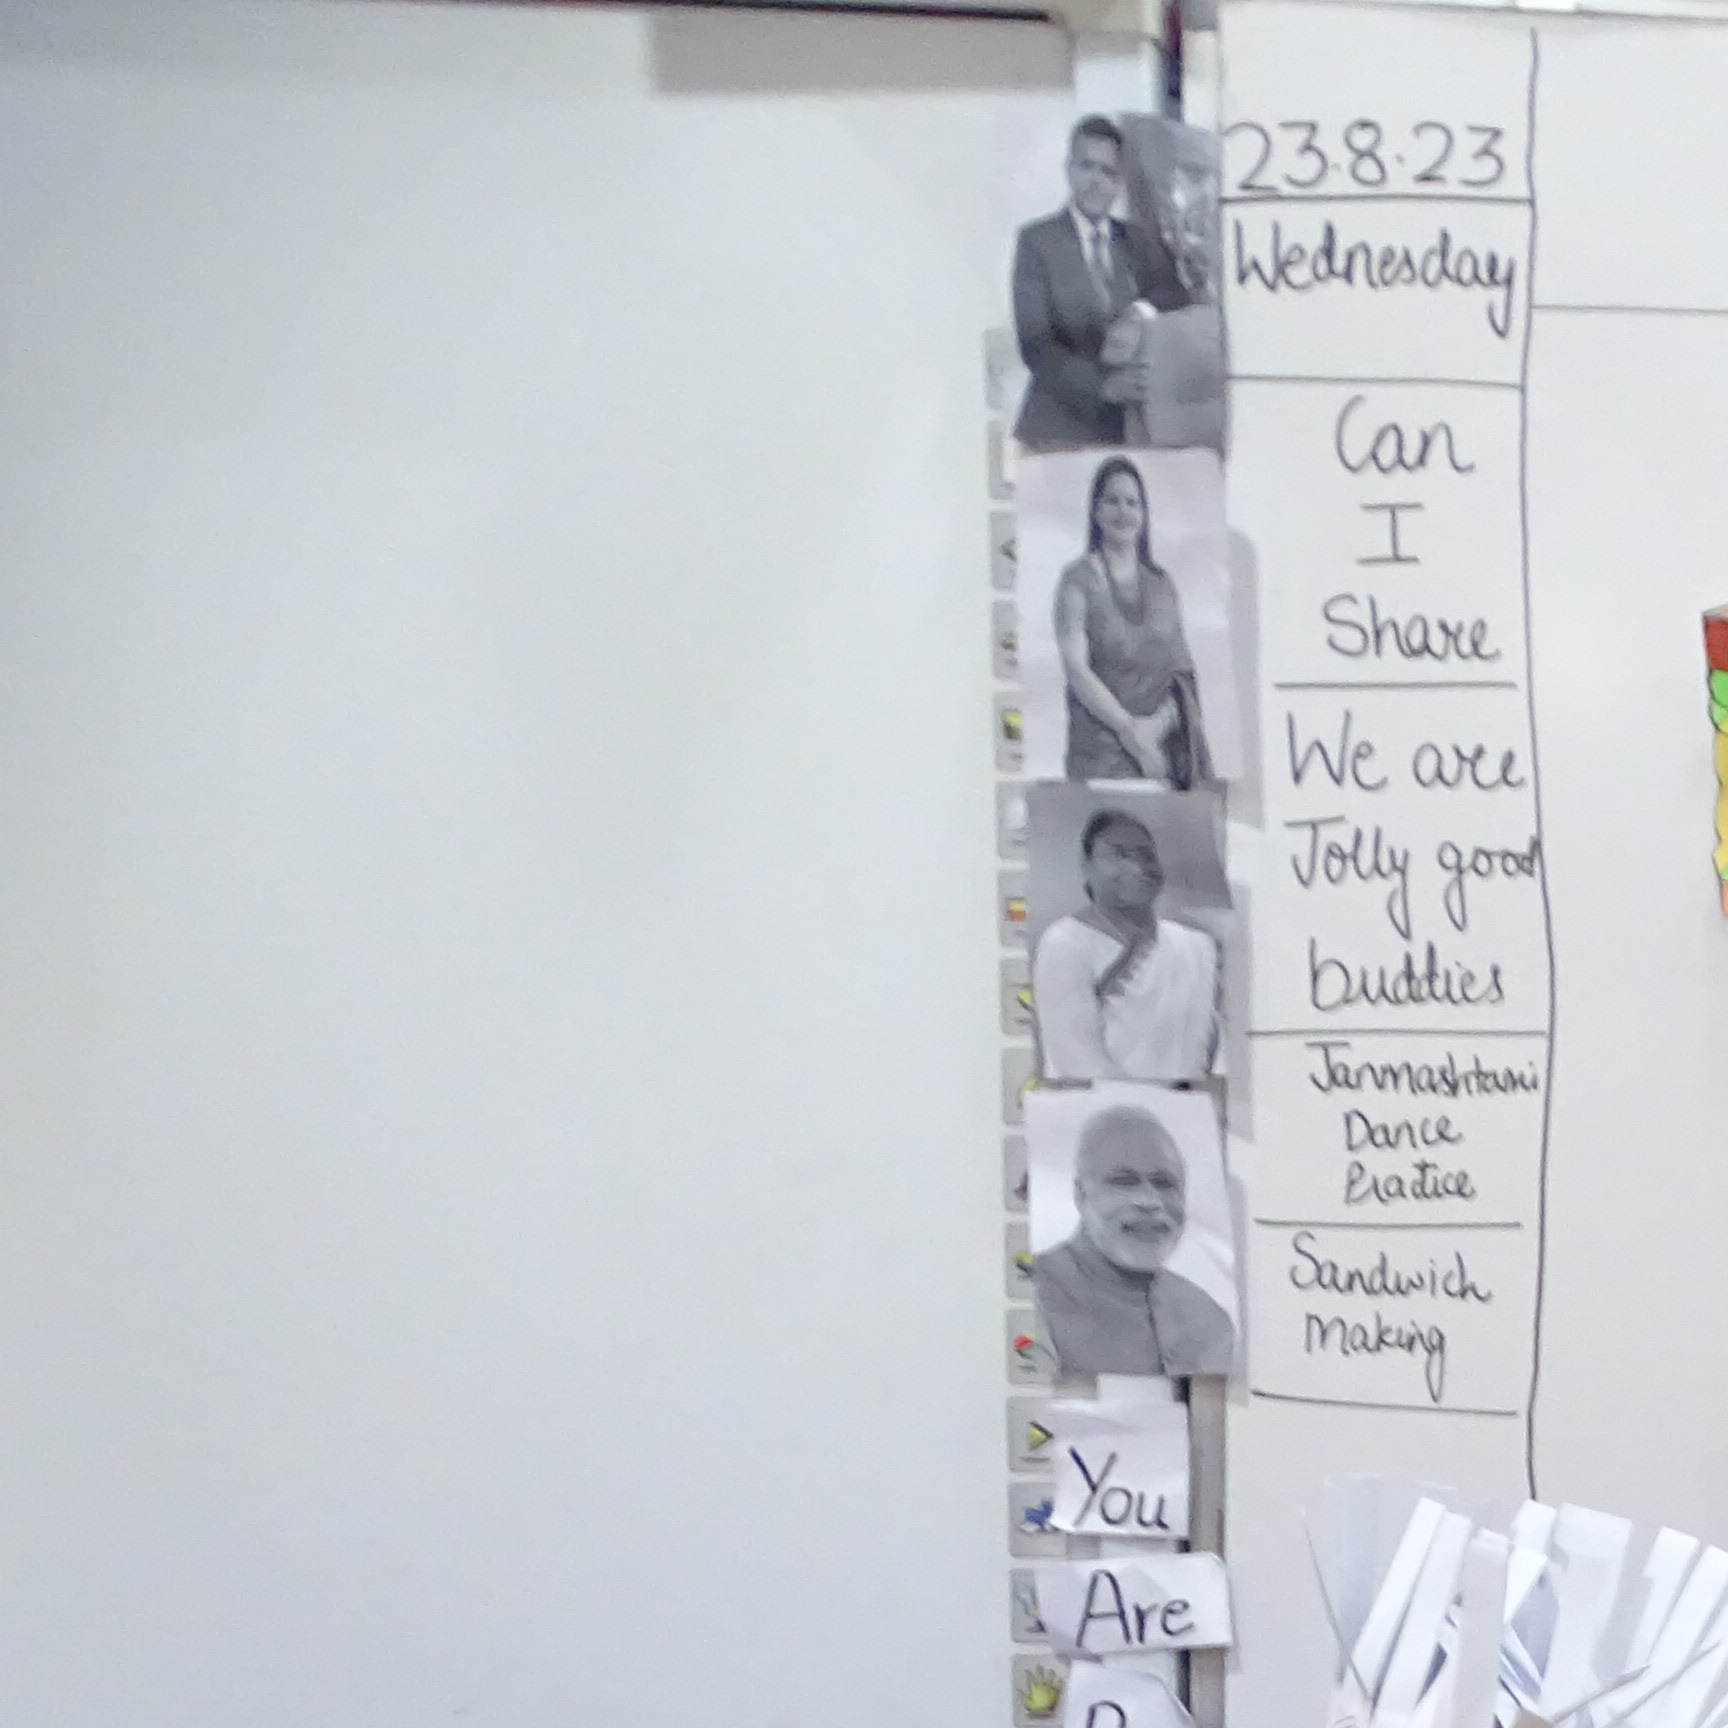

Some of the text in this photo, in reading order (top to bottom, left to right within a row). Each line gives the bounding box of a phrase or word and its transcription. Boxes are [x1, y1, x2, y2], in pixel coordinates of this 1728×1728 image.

[1223, 117, 1507, 192] 23.8.23
[1234, 218, 1516, 339] Wednesday
[1337, 395, 1475, 474] Can
[1357, 502, 1424, 564] I
[1323, 592, 1502, 660] Share
[1287, 710, 1526, 790] We are
[1284, 815, 1542, 940] Jolly good
[1308, 938, 1505, 1011] buddies
[1305, 1042, 1539, 1098] Janmashtami
[1343, 1108, 1466, 1152] Dance
[1343, 1158, 1478, 1205] Practice
[1290, 1231, 1492, 1304] Sandwich
[1068, 1445, 1171, 1530] You
[1075, 1568, 1195, 1648] Are
